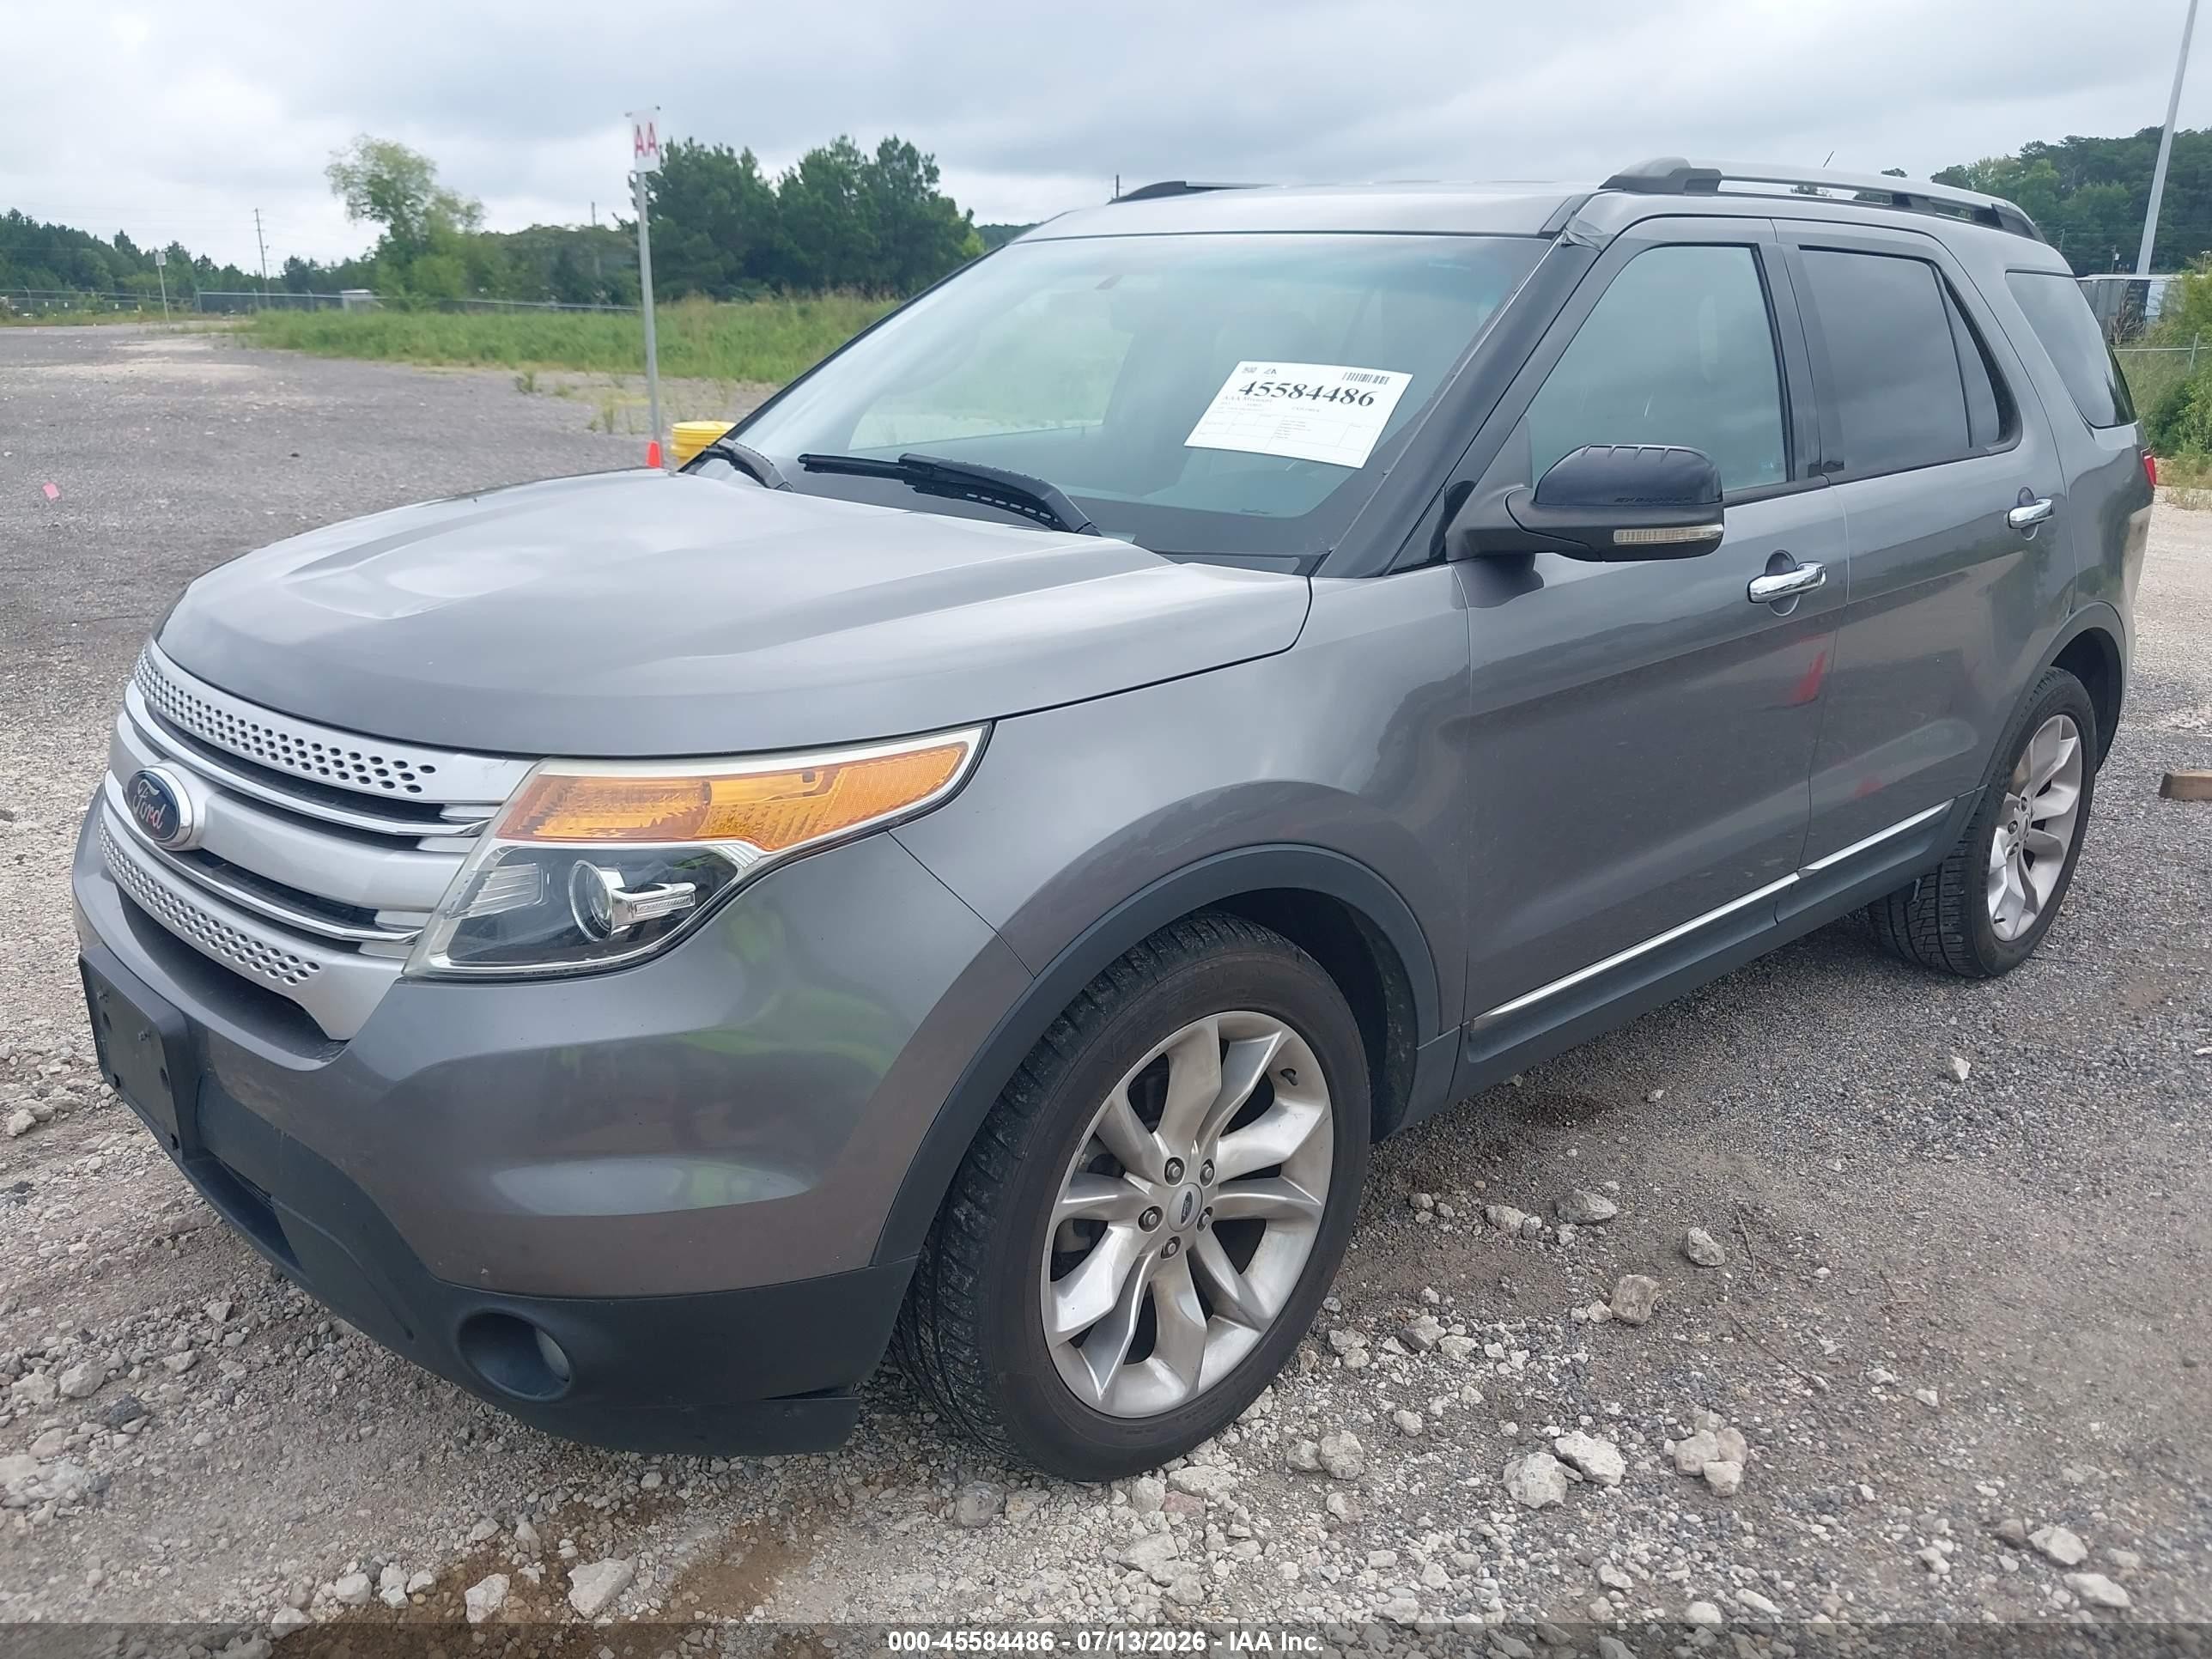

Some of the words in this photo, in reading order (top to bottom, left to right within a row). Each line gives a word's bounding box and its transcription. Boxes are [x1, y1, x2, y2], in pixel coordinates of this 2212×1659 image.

[635, 122, 659, 159] AA
[1238, 380, 1380, 407] 45584486
[132, 778, 167, 830] Ford
